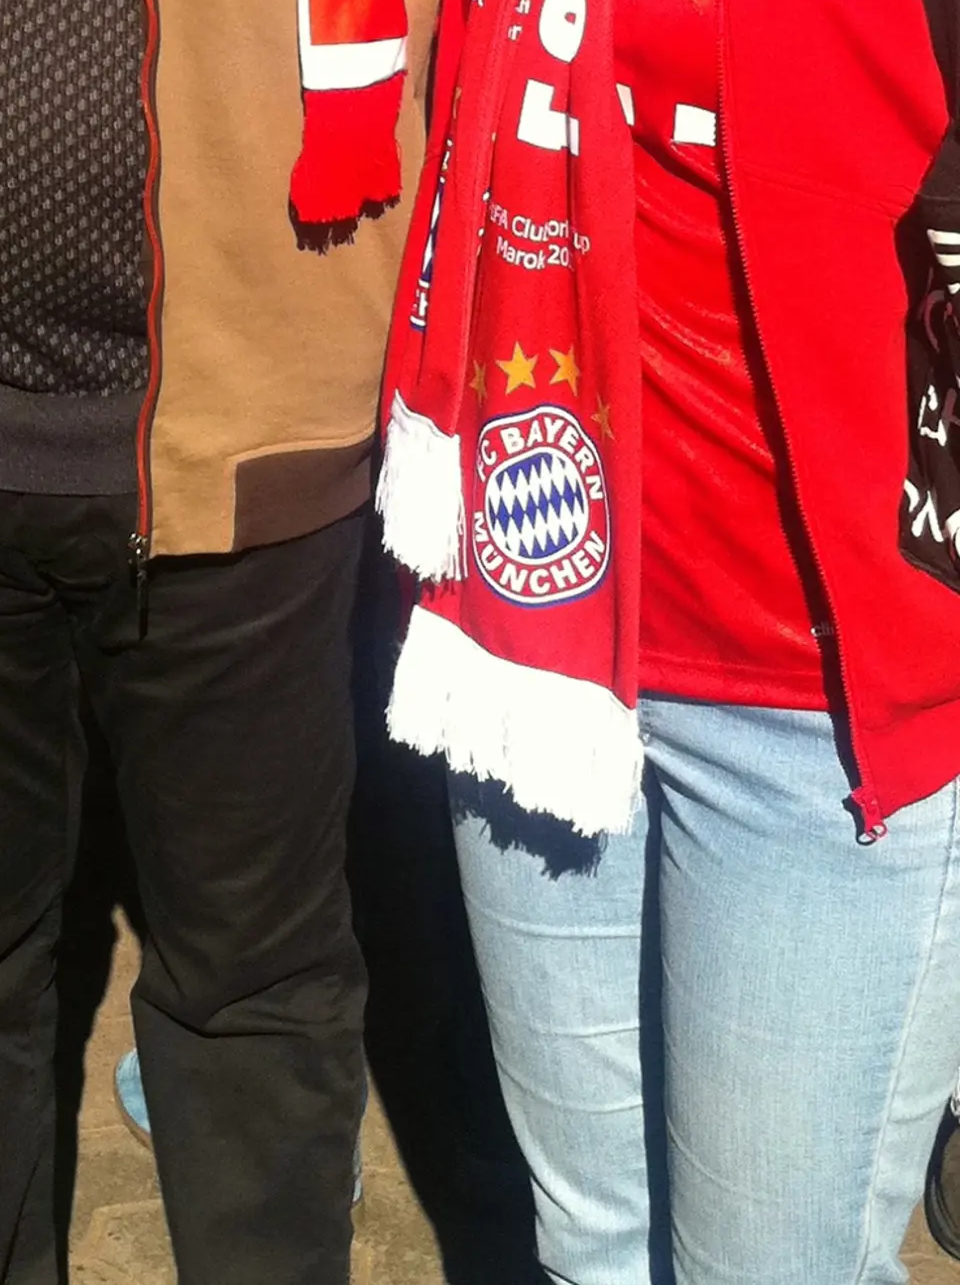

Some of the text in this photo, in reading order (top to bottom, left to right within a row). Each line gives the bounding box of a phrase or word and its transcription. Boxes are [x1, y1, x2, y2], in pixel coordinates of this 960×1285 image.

[496, 236, 546, 270] Marok
[477, 416, 604, 501] FC BAYERN
